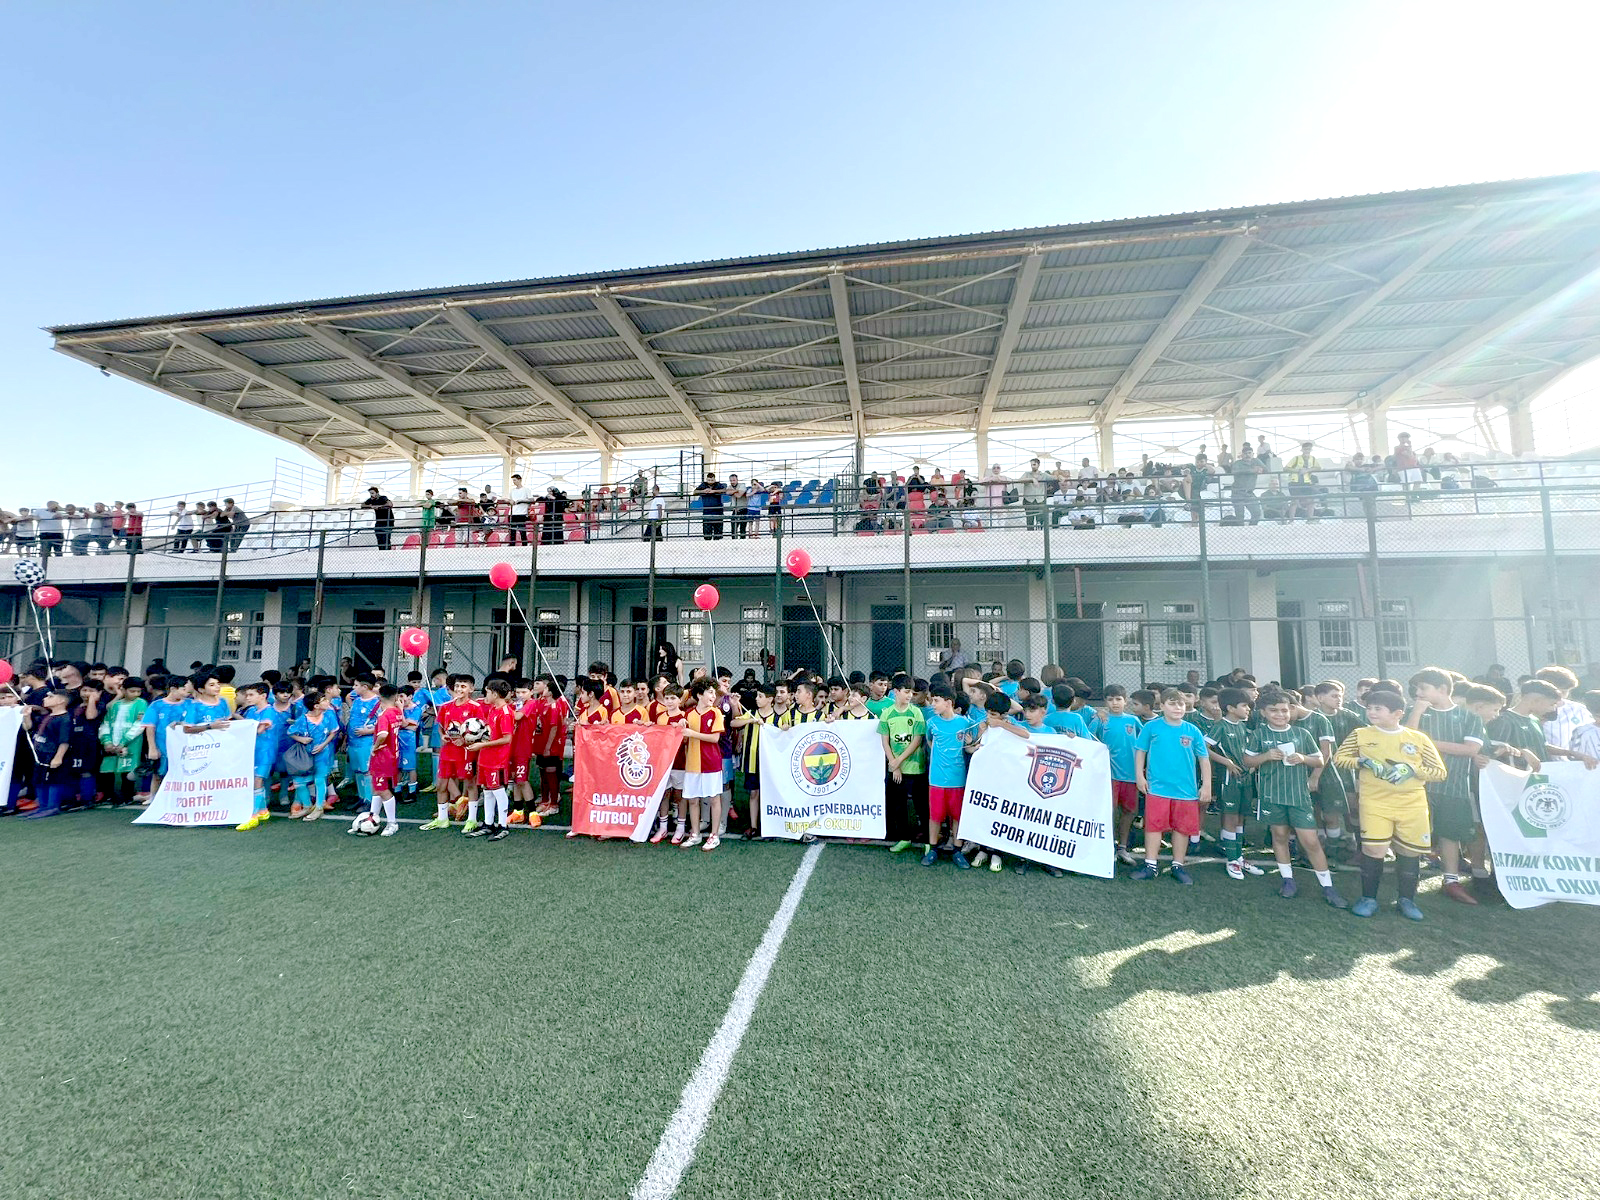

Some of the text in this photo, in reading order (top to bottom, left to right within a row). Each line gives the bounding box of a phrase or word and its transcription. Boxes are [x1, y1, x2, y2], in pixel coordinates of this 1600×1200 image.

[793, 733, 817, 783] FENERBAHÇE
[819, 733, 840, 746] SPOR
[490, 772, 497, 780] 7
[516, 765, 525, 774] 22
[200, 777, 249, 791] NUMARA
[813, 785, 830, 794] 1907
[194, 810, 229, 823] OKULU
[590, 810, 635, 826] FUTBOL
[766, 803, 882, 819] BATMAN FENERBAHÇE
[969, 789, 1105, 839] 1955 BATMAN BELEDİYE
[823, 817, 862, 831] OKULU
[990, 821, 1076, 859] SPOR KULÜBÜ
[1493, 852, 1541, 869] BATMAN
[1506, 876, 1556, 893] FUTBOL
